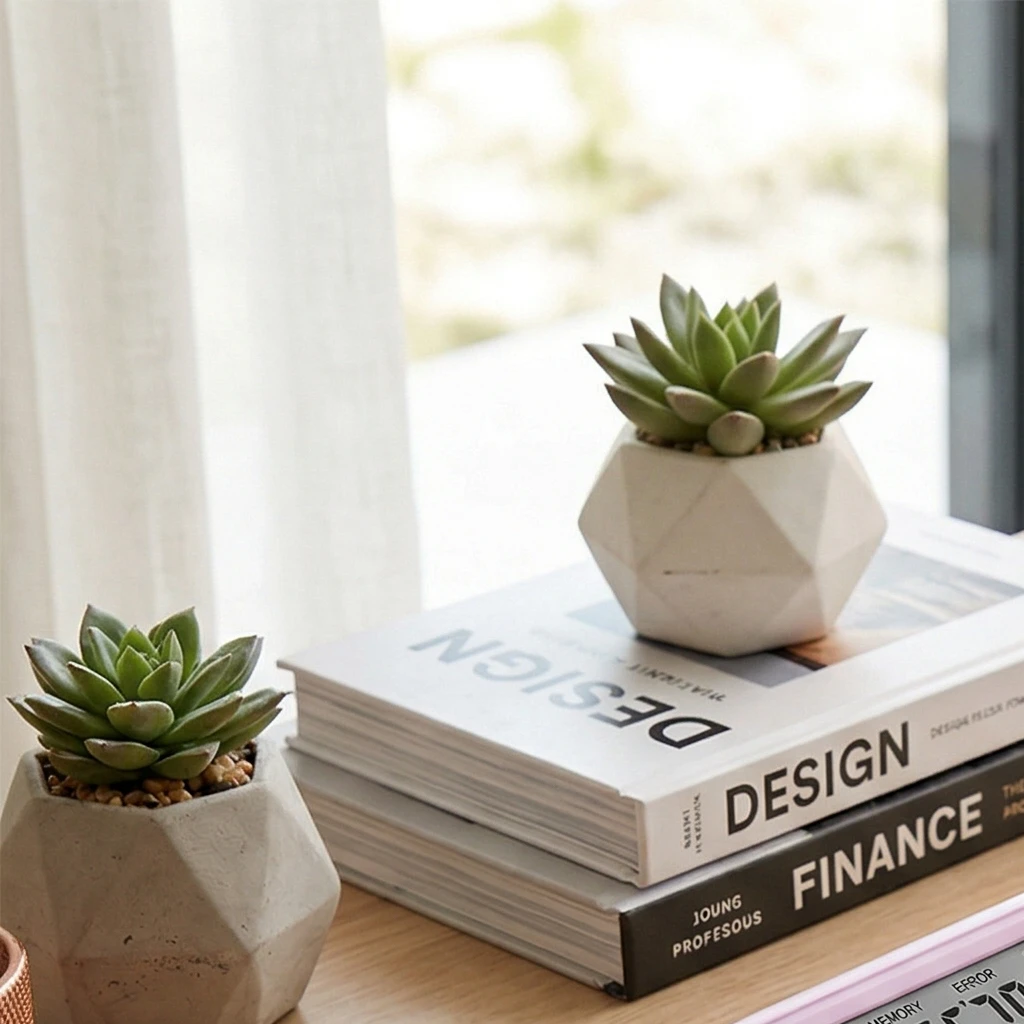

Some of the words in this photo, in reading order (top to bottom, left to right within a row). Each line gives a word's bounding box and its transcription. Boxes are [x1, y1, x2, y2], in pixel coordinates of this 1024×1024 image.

[409, 628, 731, 749] DESIGN
[726, 721, 909, 835] DESIGN
[793, 791, 983, 910] FINANCE
[672, 910, 762, 958] PROFESOUS
[693, 894, 742, 926] JOUNG
